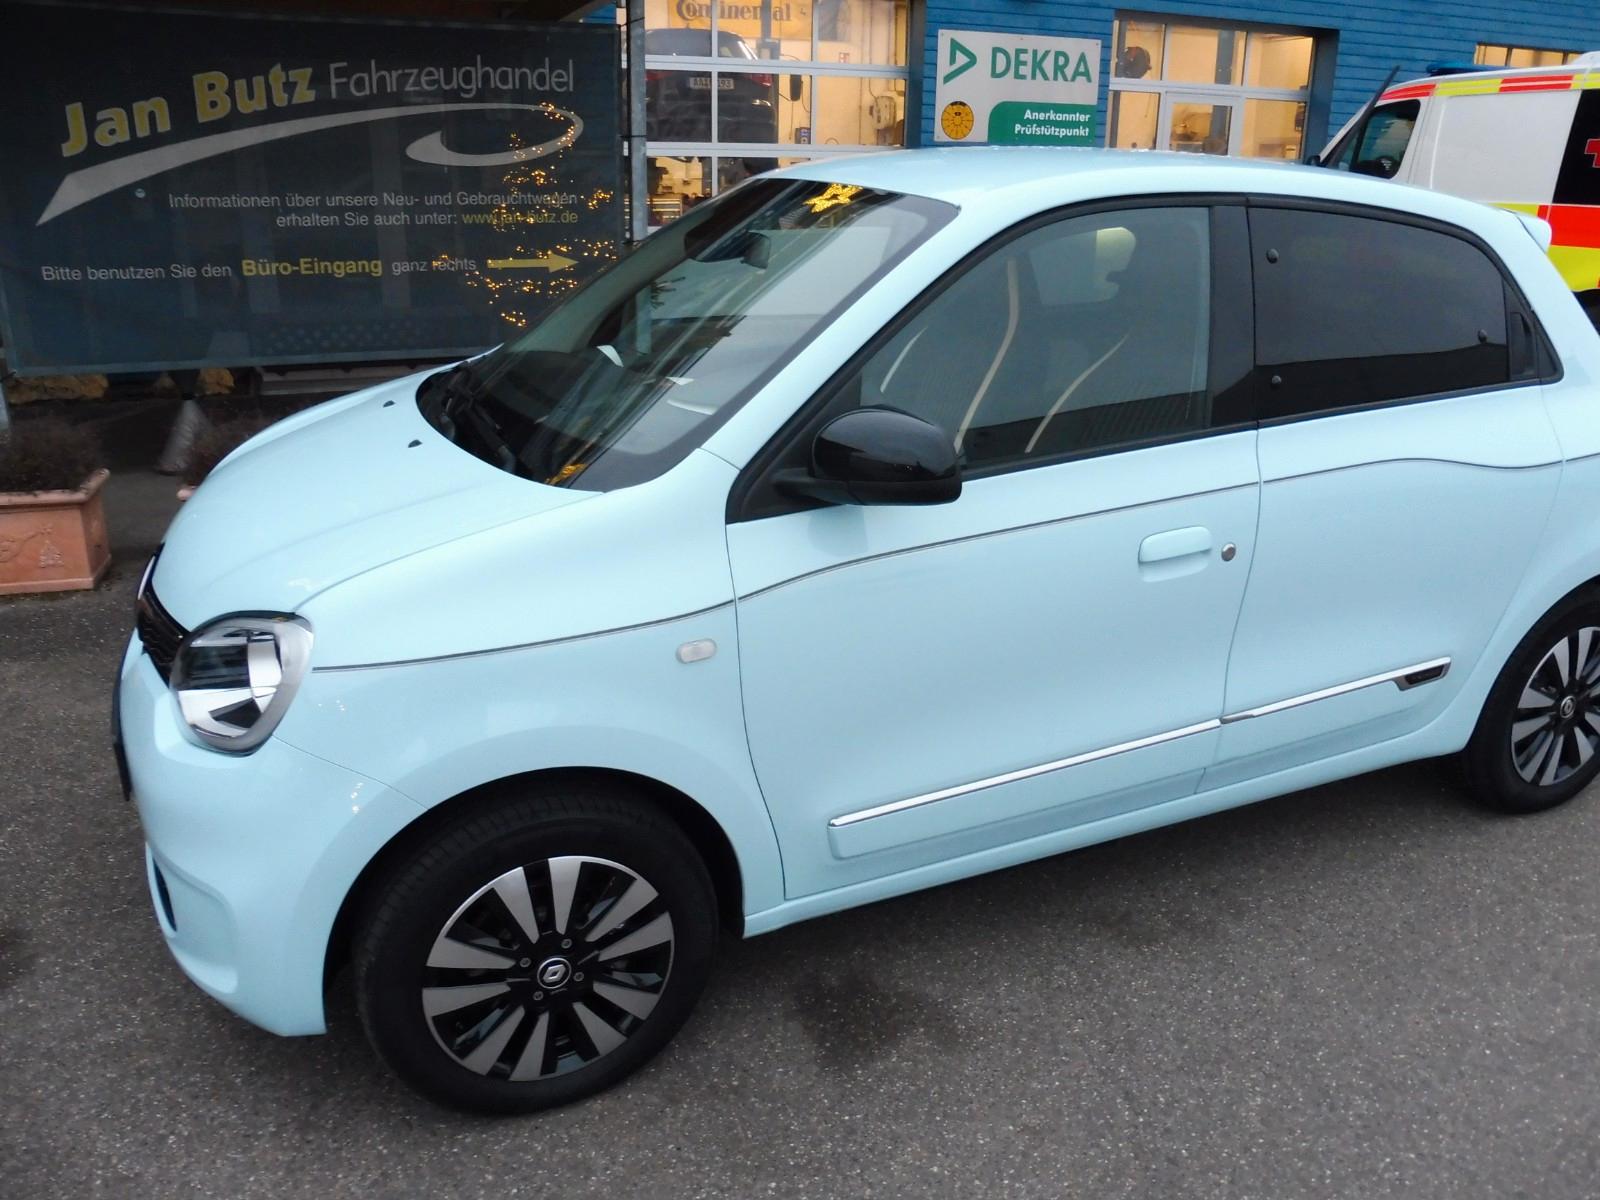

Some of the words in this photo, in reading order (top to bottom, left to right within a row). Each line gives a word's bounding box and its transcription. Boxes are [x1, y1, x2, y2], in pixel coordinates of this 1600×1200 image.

[676, 0, 792, 21] Coninenal
[990, 46, 1093, 83] DEKRA
[61, 96, 171, 157] Jan
[192, 62, 316, 123] Butz
[328, 54, 574, 99] Fahrzeughandel
[1023, 109, 1091, 122] Anerkannter
[1014, 123, 1089, 138] Prüfstützpunkt
[168, 193, 281, 208] Informationen
[285, 193, 321, 207] über
[326, 194, 378, 207] unsere
[382, 192, 419, 206] Neu-
[424, 192, 452, 206] und
[457, 191, 578, 208] Gebrauchtwagen
[276, 213, 340, 227] erhalten
[344, 212, 369, 226] Sie
[374, 211, 411, 225] auch
[415, 211, 458, 225] unter:
[41, 265, 82, 281] Bitte
[87, 265, 166, 280] benutzen
[170, 264, 198, 278] Sie
[201, 263, 232, 278] den
[241, 256, 383, 278] Büro-Eingang
[392, 259, 427, 275] ganz
[432, 257, 477, 272] rechts
